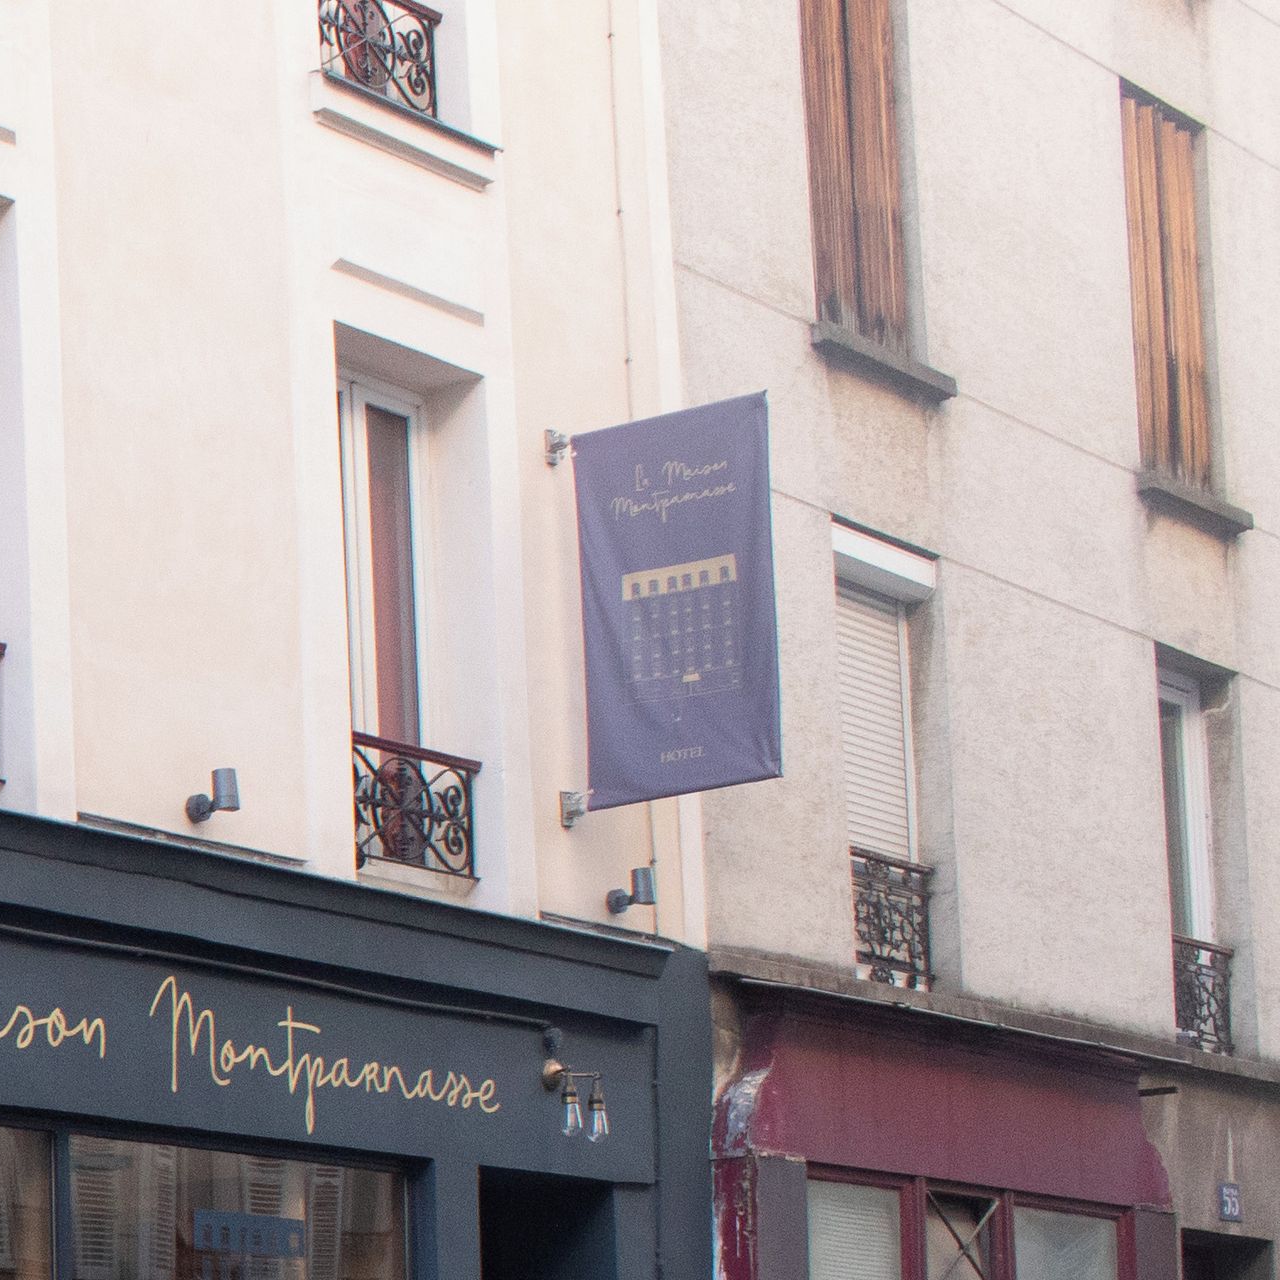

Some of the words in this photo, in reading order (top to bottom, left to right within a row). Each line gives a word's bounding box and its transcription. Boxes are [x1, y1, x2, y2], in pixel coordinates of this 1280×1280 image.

[634, 463, 652, 492] La
[149, 975, 501, 1135] Montparnasse
[1222, 1186, 1240, 1216] 55
